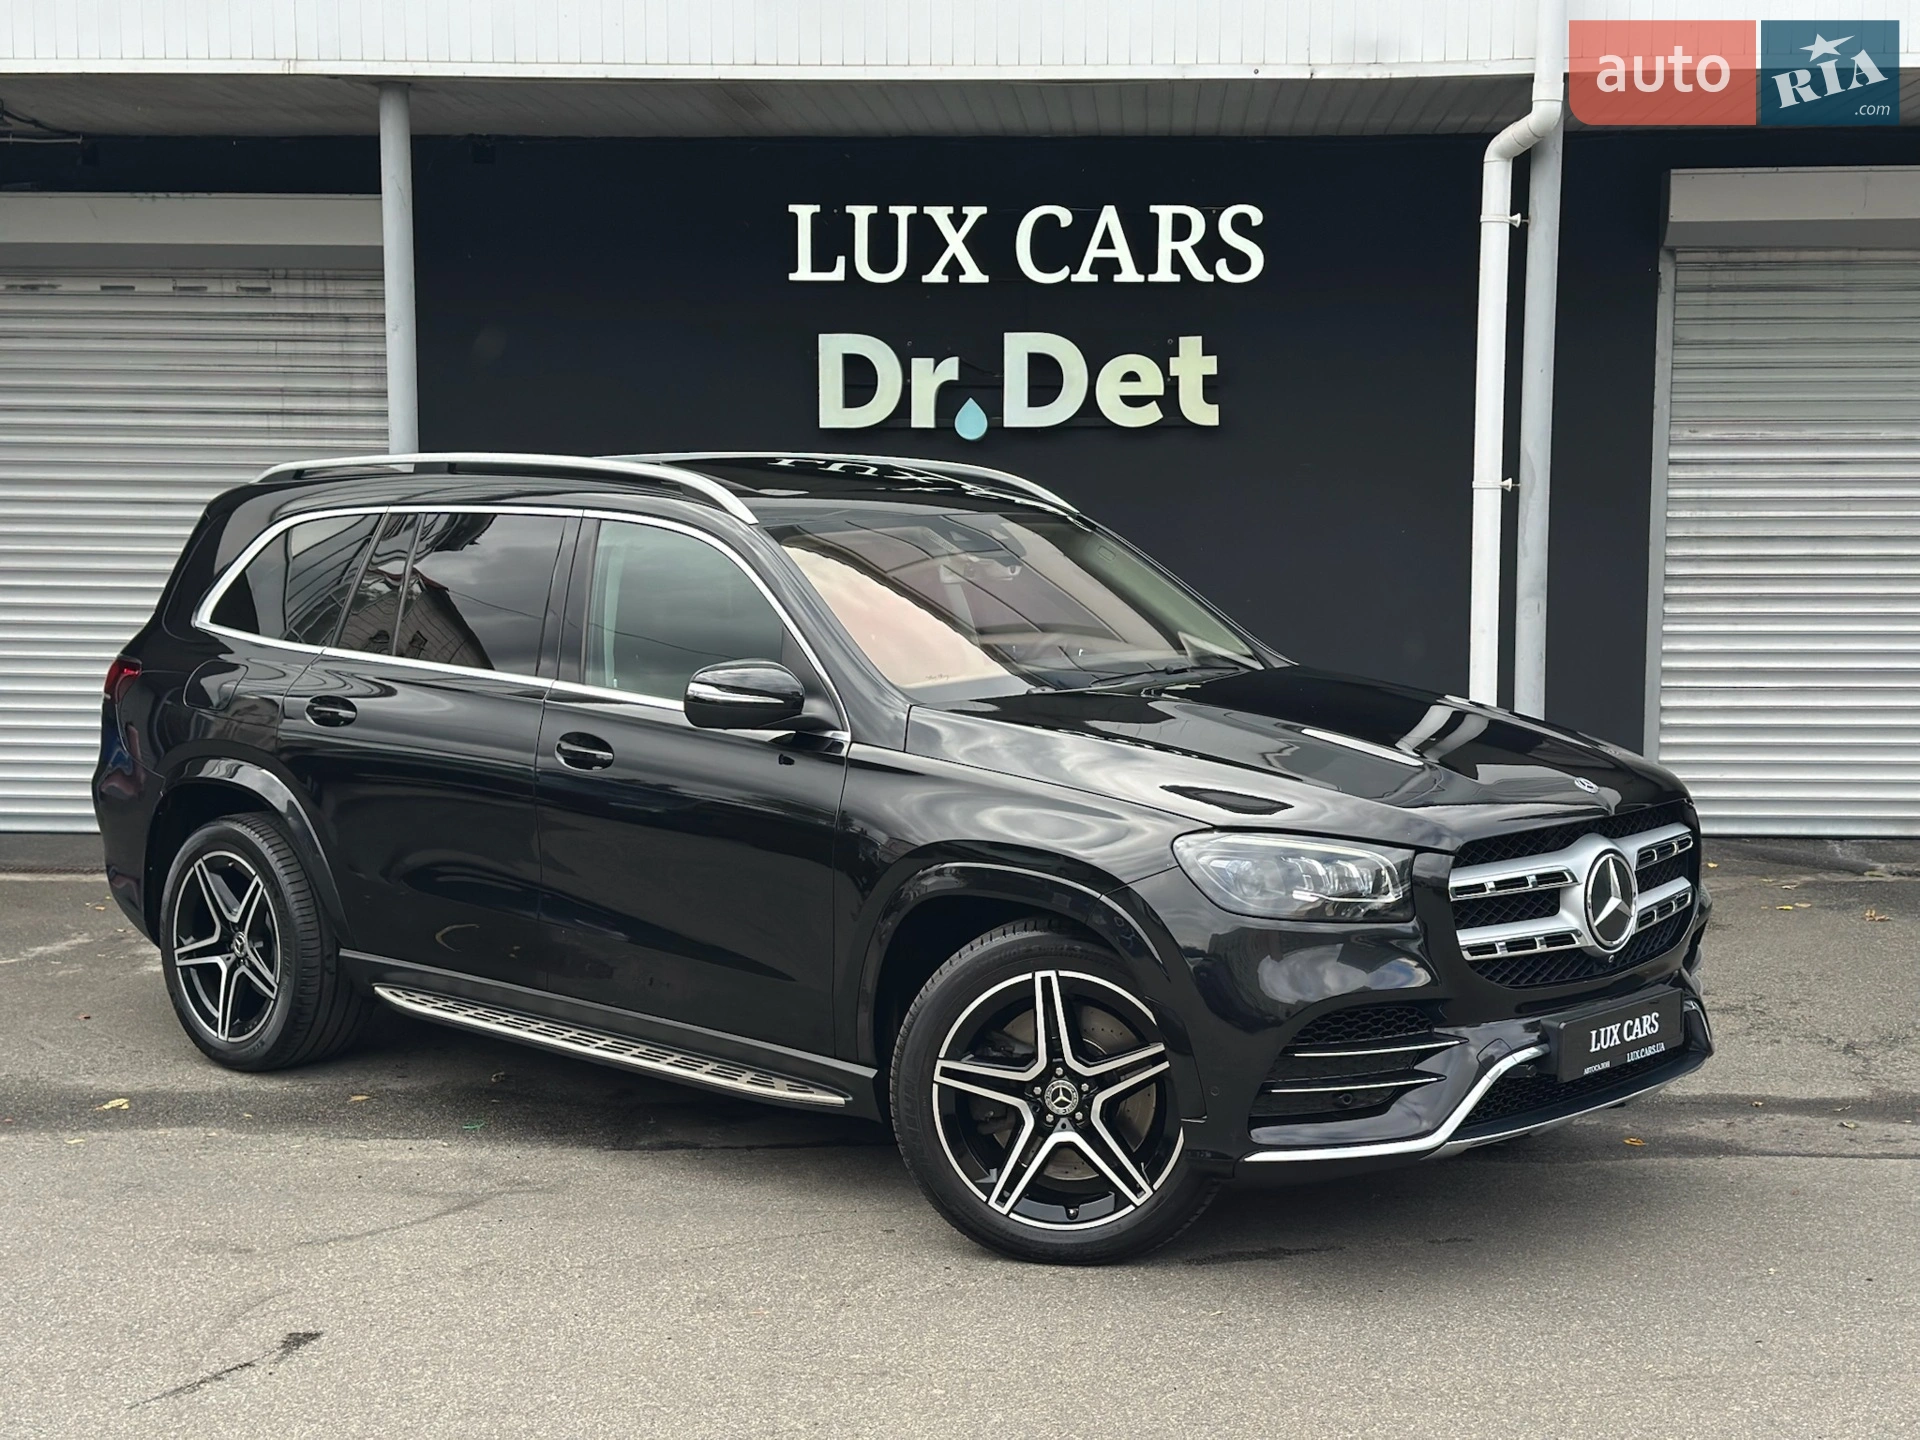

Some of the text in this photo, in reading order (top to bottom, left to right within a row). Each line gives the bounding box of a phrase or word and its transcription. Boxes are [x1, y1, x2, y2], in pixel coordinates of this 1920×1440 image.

[788, 204, 1265, 284] LUX CARS
[1589, 1012, 1660, 1053] LUX CARS
